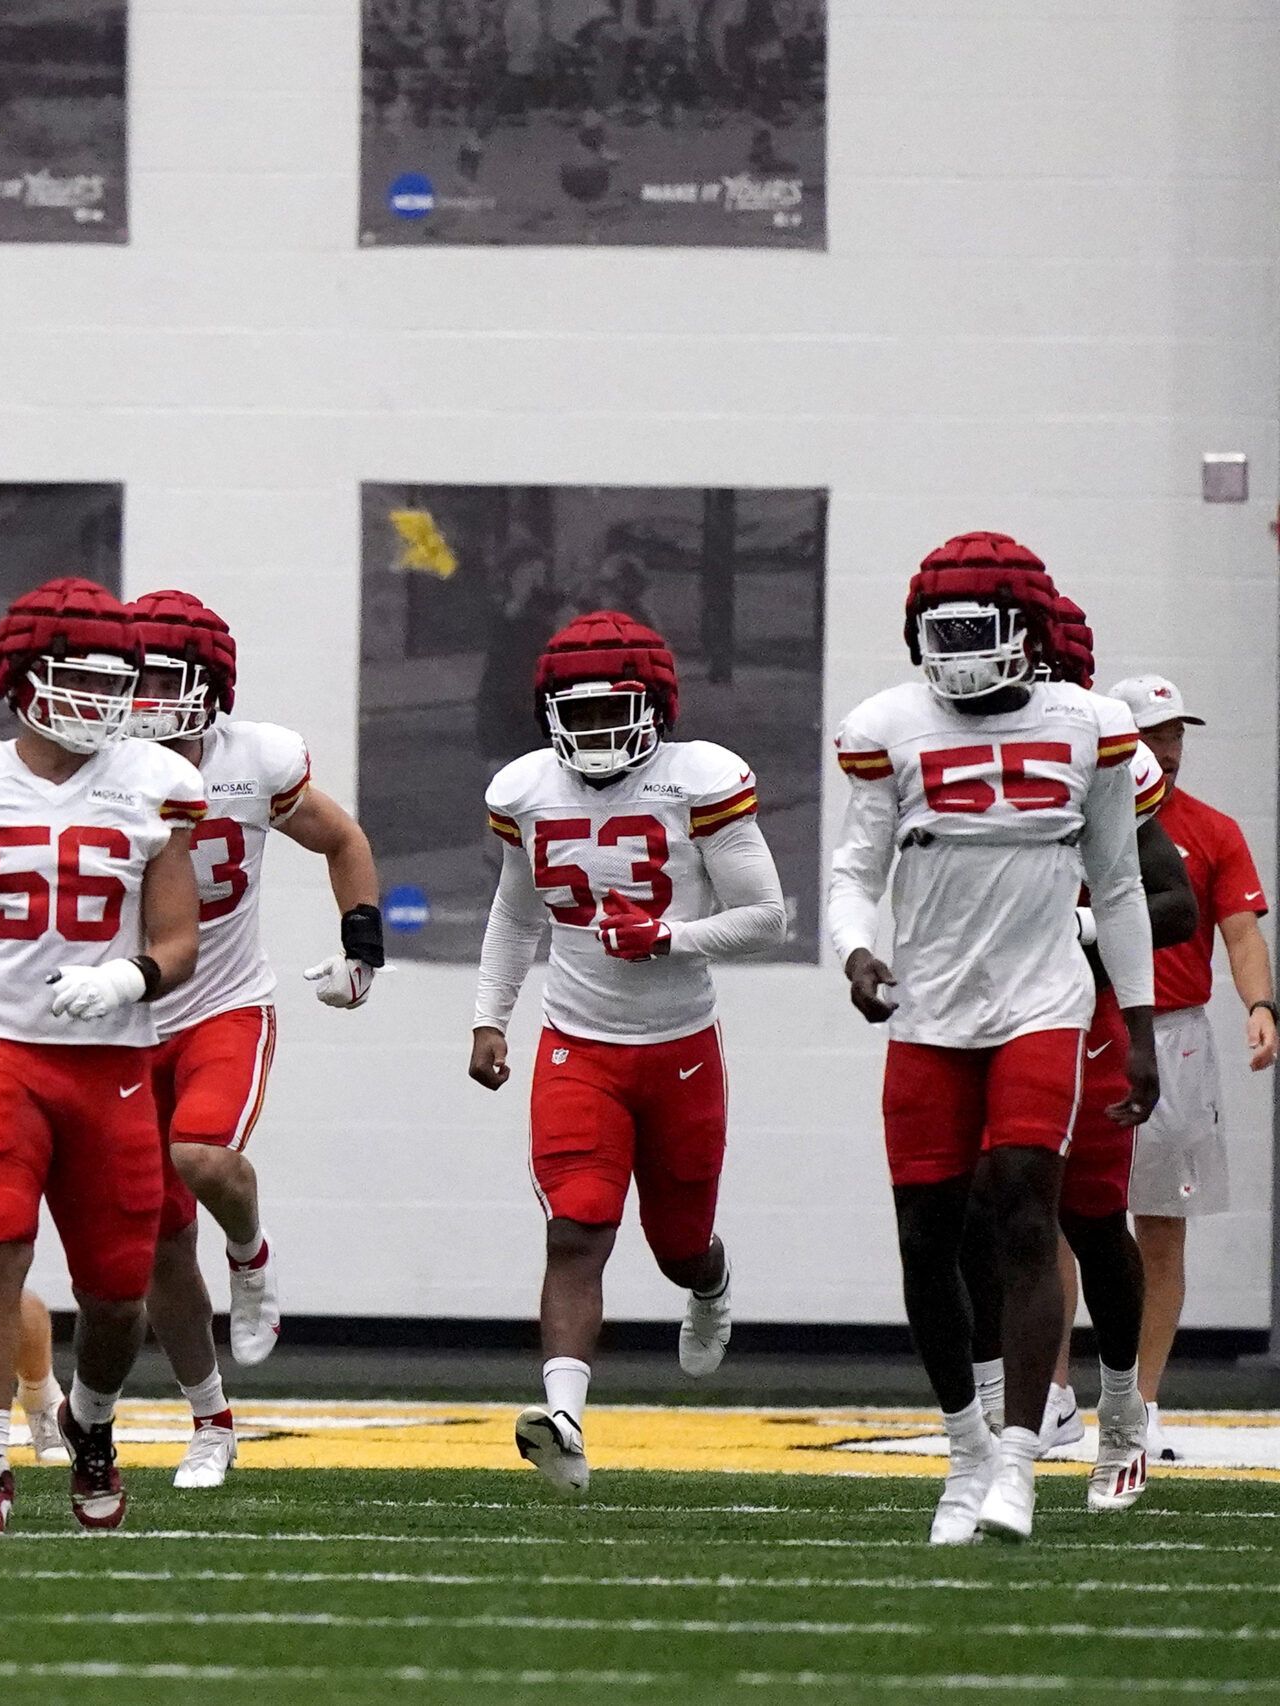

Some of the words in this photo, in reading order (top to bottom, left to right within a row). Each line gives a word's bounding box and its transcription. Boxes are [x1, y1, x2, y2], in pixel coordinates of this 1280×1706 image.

[211, 782, 253, 793] MOSAIC
[643, 784, 683, 795] MOSAIC
[919, 742, 1072, 814] 55
[189, 817, 249, 923] 3
[534, 814, 673, 927] 53
